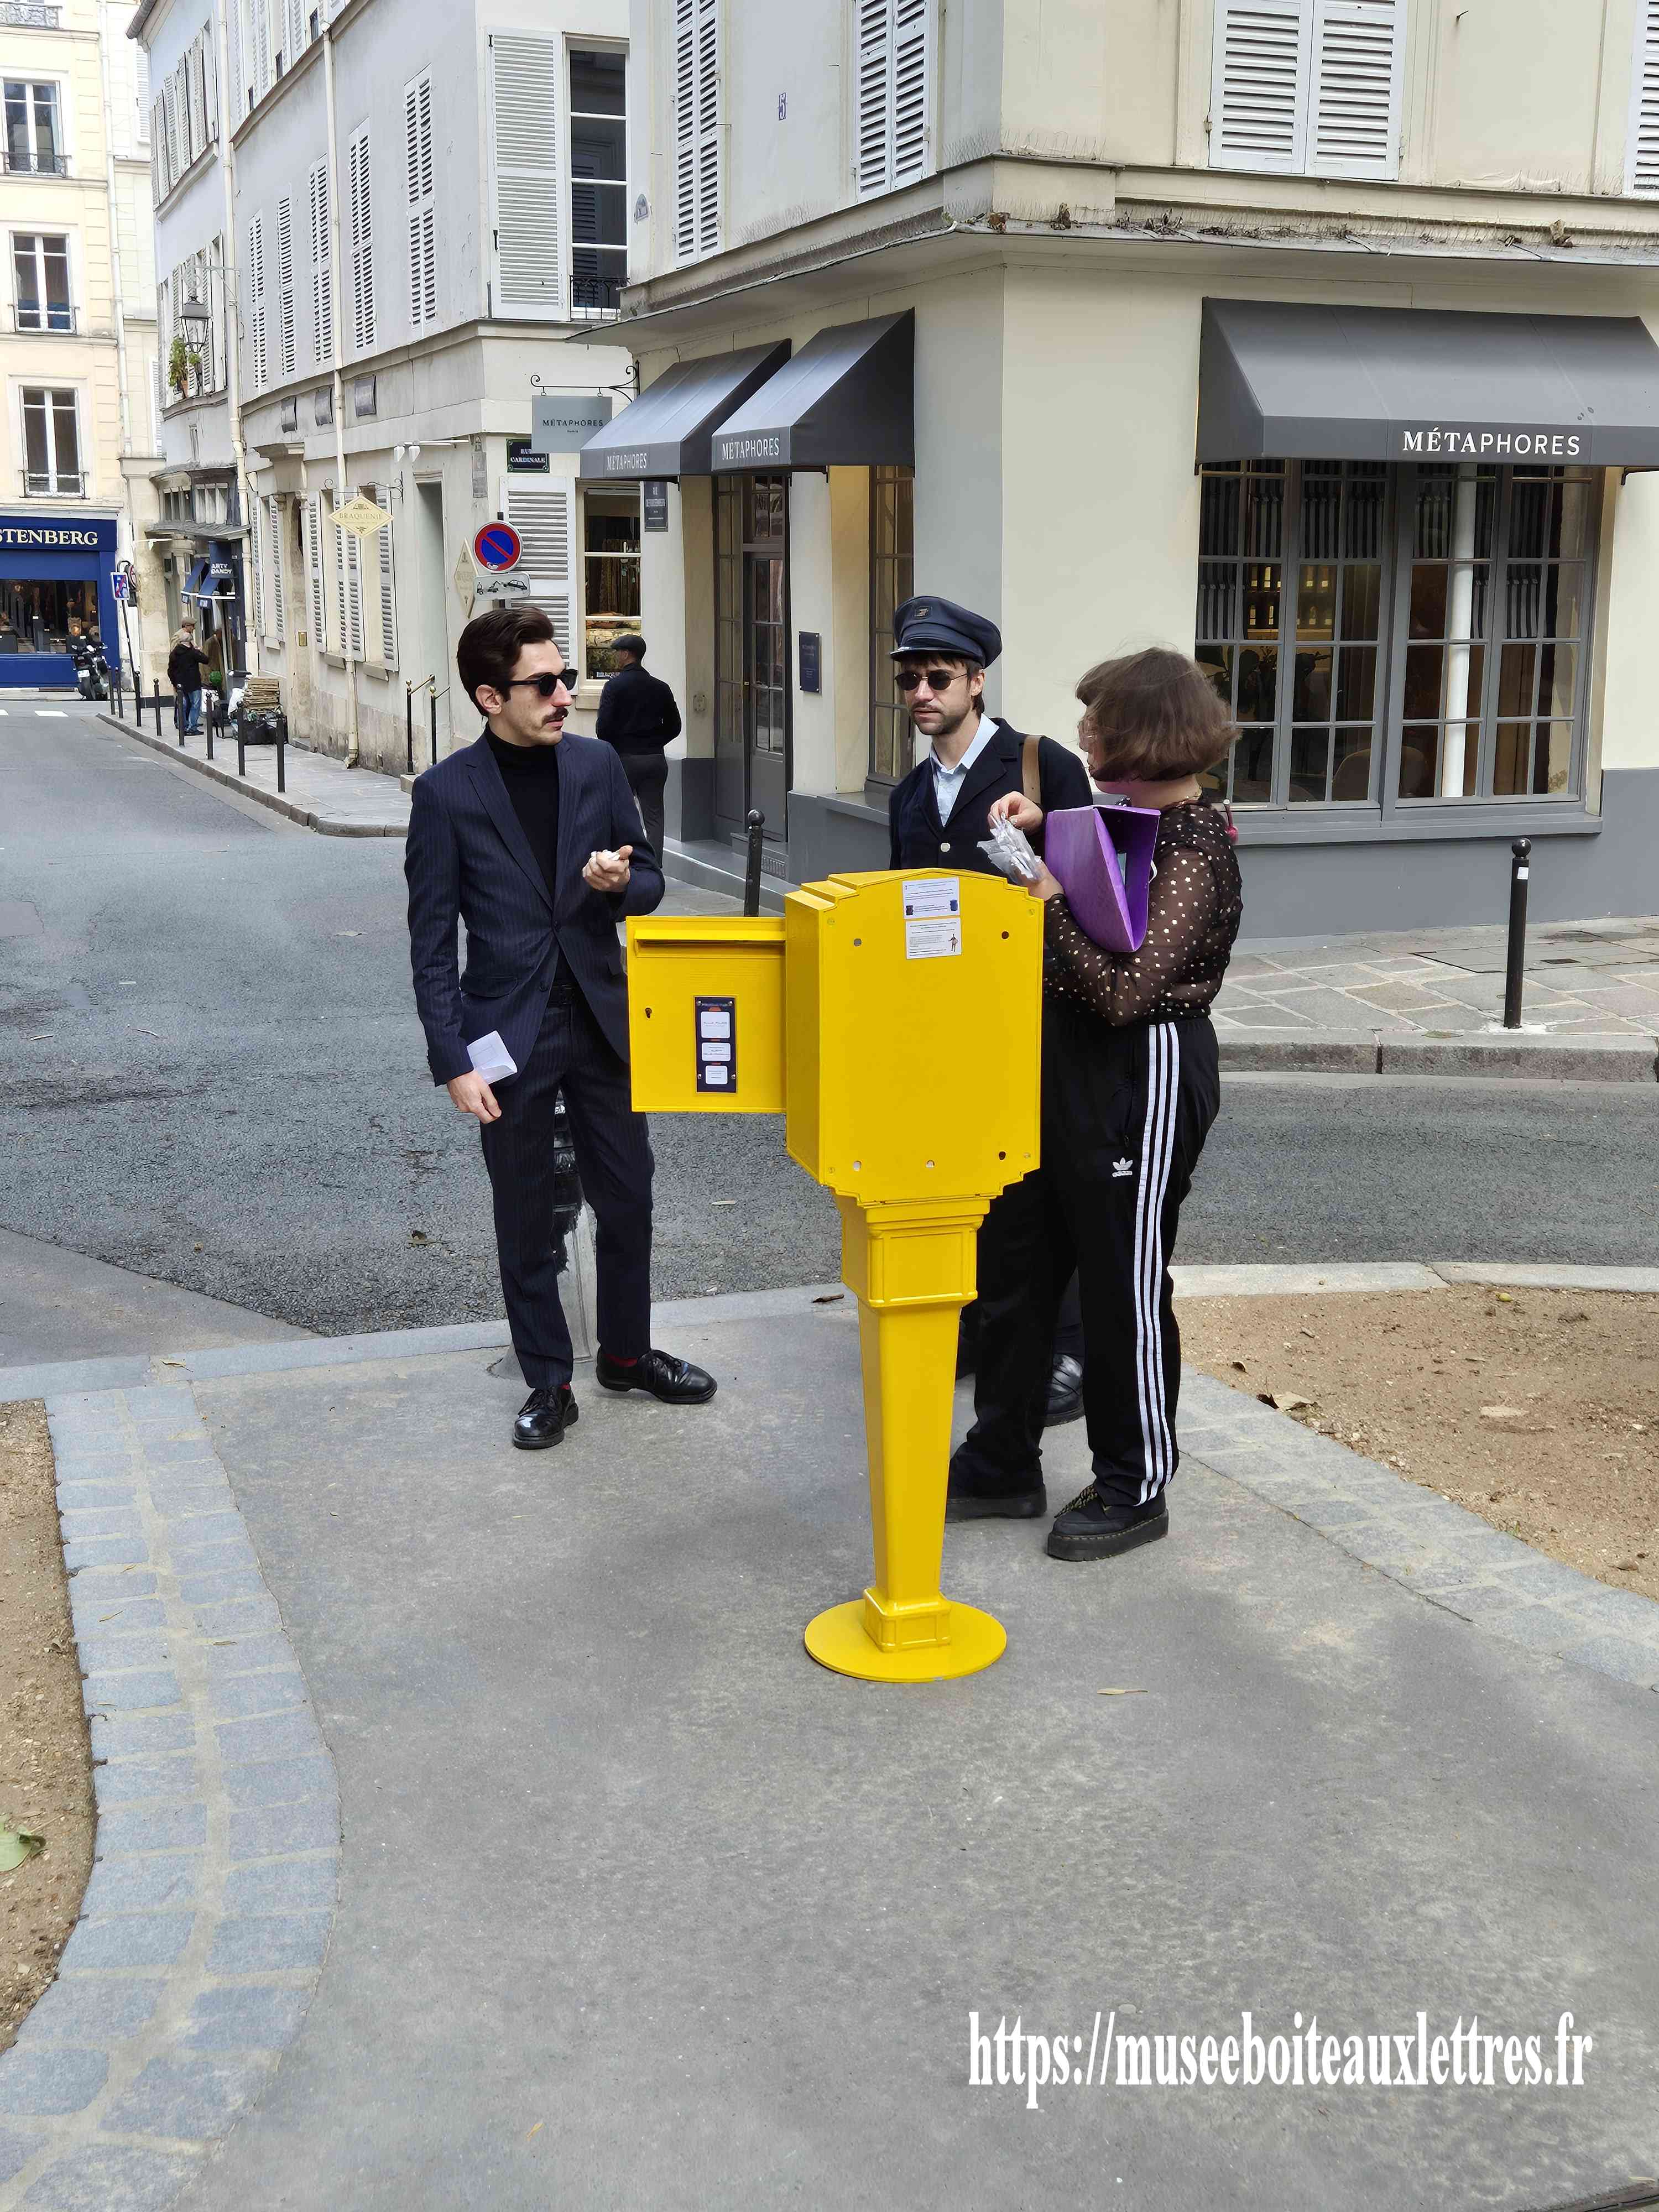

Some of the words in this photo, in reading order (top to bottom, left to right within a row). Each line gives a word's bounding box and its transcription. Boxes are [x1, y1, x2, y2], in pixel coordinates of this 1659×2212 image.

[722, 438, 779, 460] MÉTAPHORES
[1403, 427, 1580, 455] MÉTAPHORES
[607, 452, 647, 470] MÉTAPHORES
